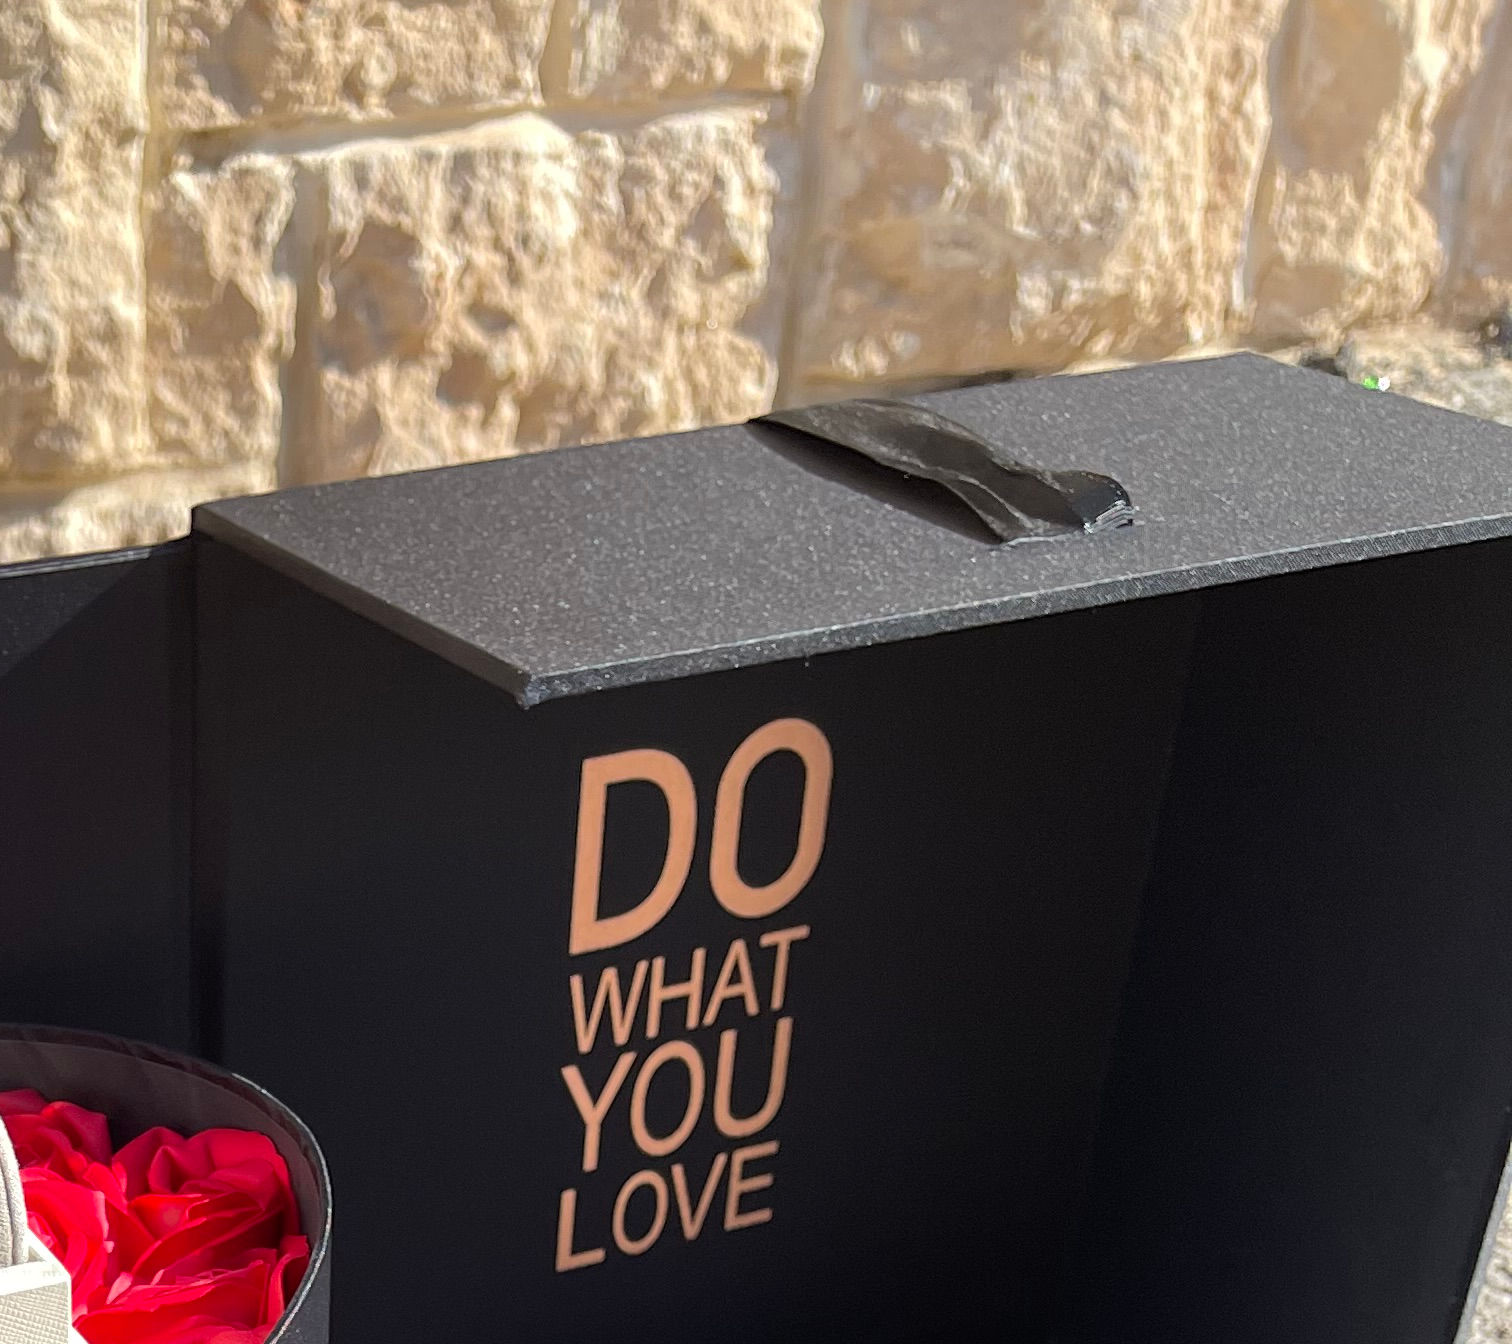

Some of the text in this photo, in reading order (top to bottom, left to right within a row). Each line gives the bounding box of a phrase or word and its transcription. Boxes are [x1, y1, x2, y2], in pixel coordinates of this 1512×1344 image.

[568, 717, 834, 956] DO
[568, 924, 811, 1055] WHAT
[560, 1016, 794, 1173] YOU
[554, 1139, 780, 1273] LOVE
